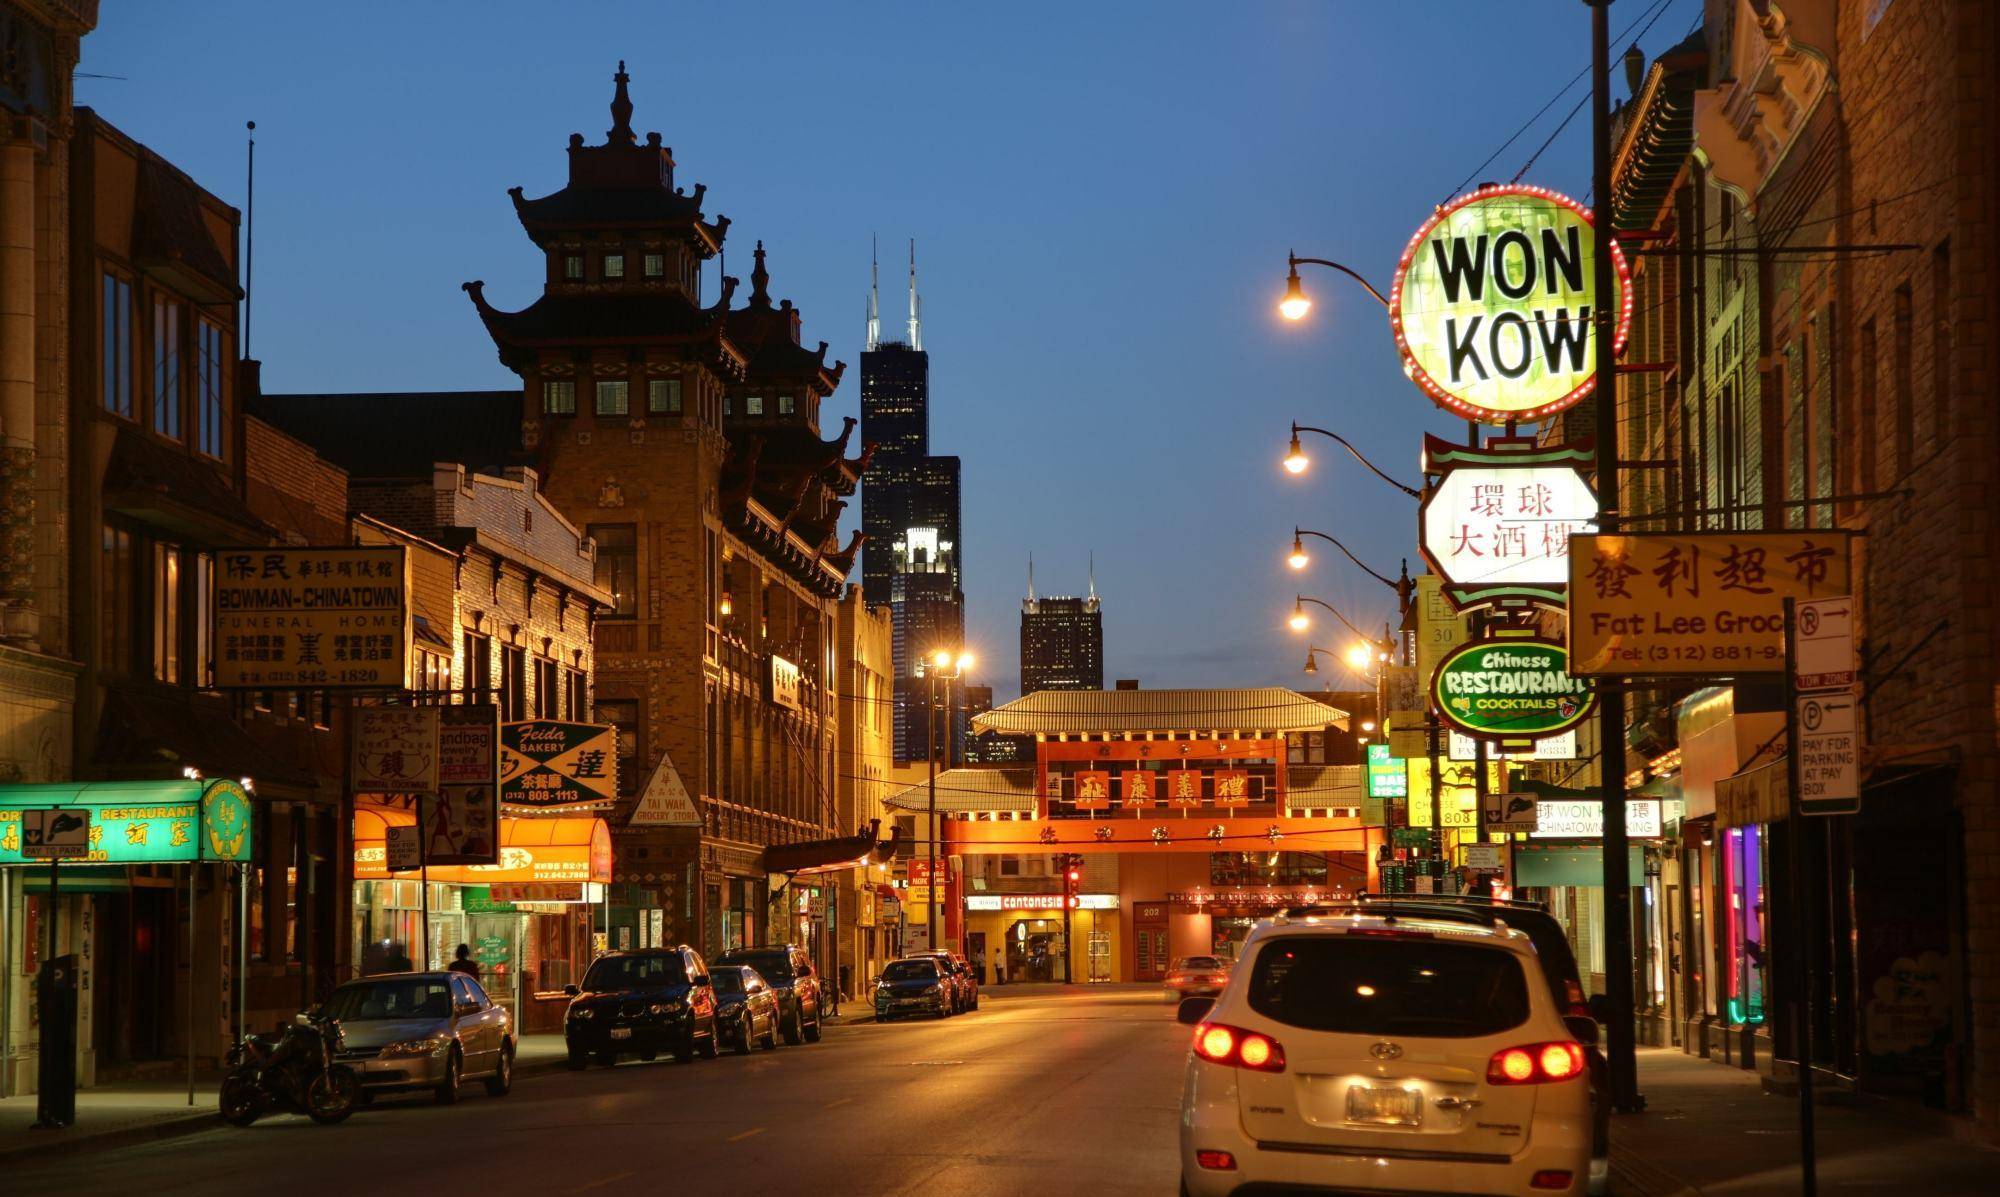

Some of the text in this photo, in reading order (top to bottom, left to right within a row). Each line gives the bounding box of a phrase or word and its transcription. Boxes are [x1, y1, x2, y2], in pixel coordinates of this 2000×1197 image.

[1431, 224, 1585, 304] WON
[1445, 305, 1591, 384] KOW
[1469, 483, 1553, 517] 環球
[1449, 523, 1573, 558] 大酒樓
[1585, 541, 1837, 600] 發利超市
[219, 587, 399, 609] BOWMAN-CHINATOWN
[218, 614, 400, 629] FUNERAL HOME
[1590, 609, 1785, 636] Fat Lee Groc
[1433, 627, 1453, 643] 30
[1480, 652, 1552, 669] Chinese
[1648, 645, 1705, 662] (312)
[1445, 671, 1587, 695] RESTAURANT
[1801, 672, 1851, 687] TOW ZONE
[1476, 698, 1559, 710] COCKTAILS
[439, 730, 488, 748] andbag
[516, 723, 567, 744] Feida
[519, 743, 566, 753] BAKERY
[1803, 737, 1851, 751] PAY FOR
[566, 749, 607, 779] 達
[1803, 751, 1854, 765] PARKING
[1805, 767, 1843, 779] AT PAY
[521, 773, 562, 789] 茶餐廳
[1804, 782, 1826, 795] BOX
[528, 789, 578, 801] 808-1113
[647, 798, 686, 810] TAI WAH
[101, 808, 196, 822] RESTAURANT
[1558, 805, 1591, 819] WON
[1518, 824, 1535, 832] PARK
[24, 846, 41, 856] PAY
[45, 846, 59, 856] TO
[60, 845, 83, 856] PARK
[810, 898, 825, 906] ONE
[1003, 896, 1064, 908] cantonesia
[1143, 907, 1160, 917] 202
